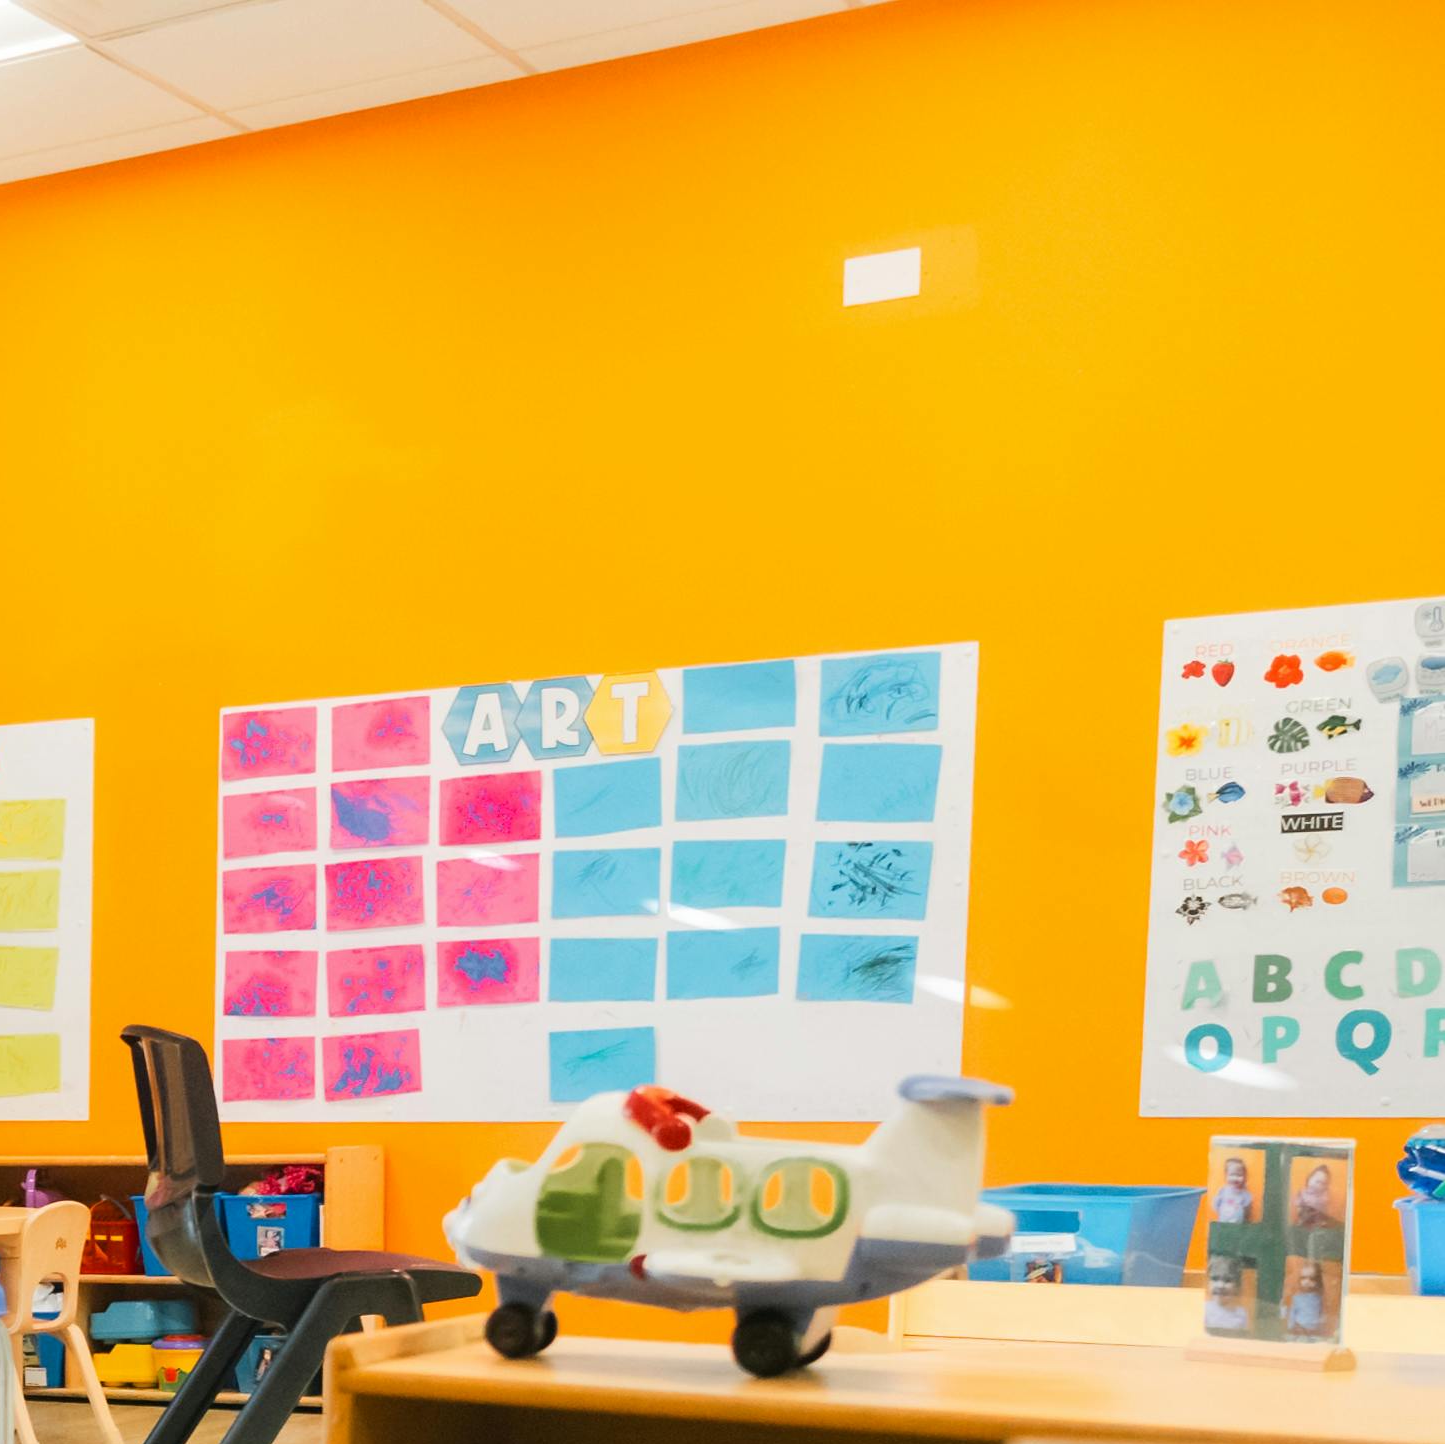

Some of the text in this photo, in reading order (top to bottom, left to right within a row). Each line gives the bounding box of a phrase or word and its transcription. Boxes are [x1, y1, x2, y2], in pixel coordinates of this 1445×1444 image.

[1195, 643, 1234, 657] RED
[1285, 697, 1352, 714] GREEN
[463, 681, 650, 756] ART
[1186, 766, 1233, 782] BLUE
[1281, 758, 1357, 775] PURPLE
[1189, 824, 1232, 838] PINK
[1281, 813, 1344, 832] WHITE
[1183, 875, 1244, 891] BLACK
[1280, 871, 1356, 885] BROWN
[1252, 954, 1294, 1003] B
[1324, 950, 1364, 1001] C
[1263, 1015, 1301, 1063] P
[1335, 1009, 1392, 1076] Q
